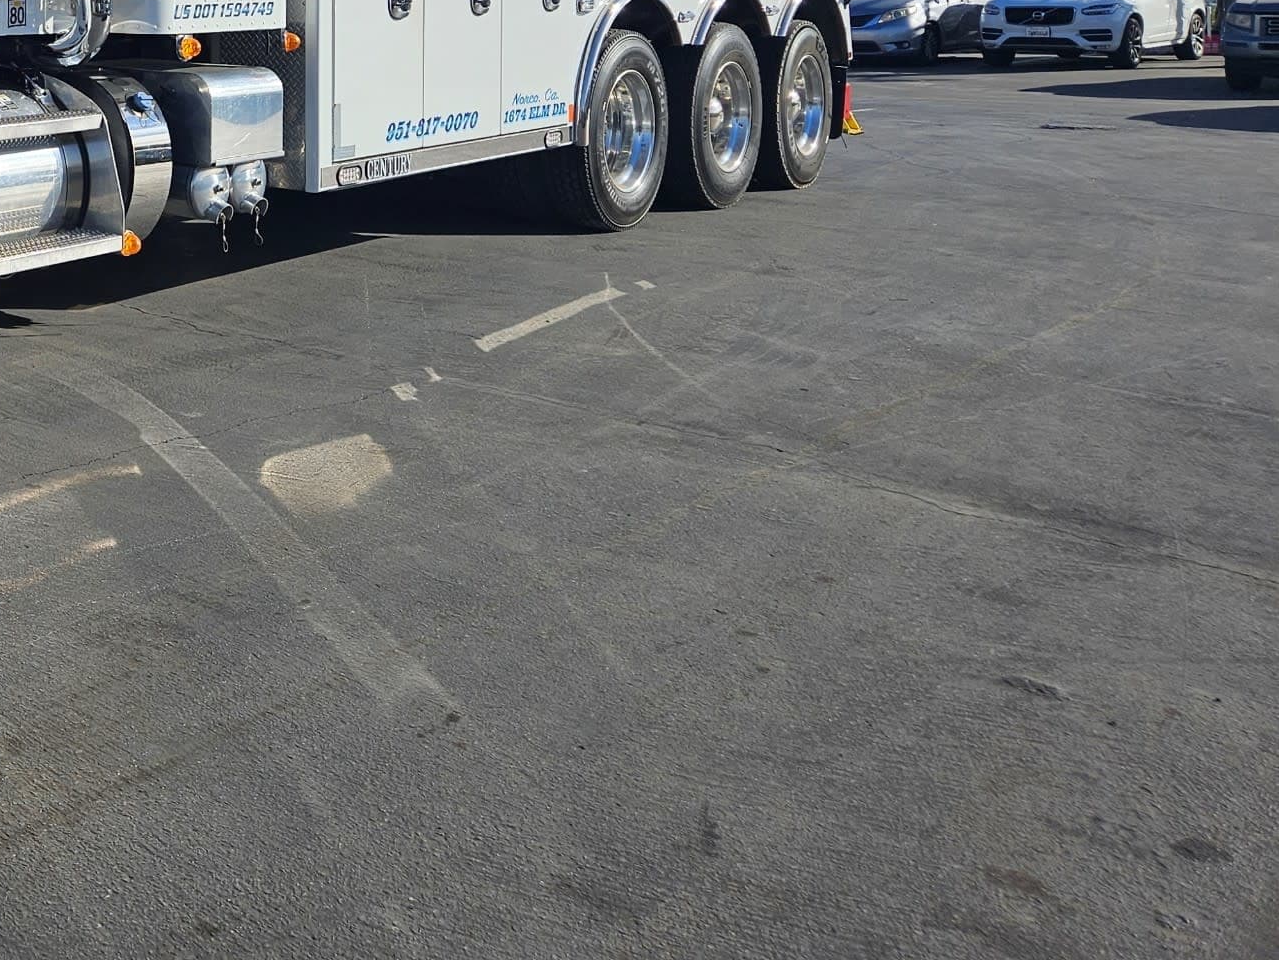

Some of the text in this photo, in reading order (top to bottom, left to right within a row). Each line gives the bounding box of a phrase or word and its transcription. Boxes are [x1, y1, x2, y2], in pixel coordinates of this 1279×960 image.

[9, 6, 25, 25] 80
[174, 1, 274, 20] US DOT 1594749
[504, 108, 527, 124] 1674
[528, 104, 551, 120] ELM
[386, 111, 478, 141] 951-817-0070
[365, 153, 411, 180] CENTURY
